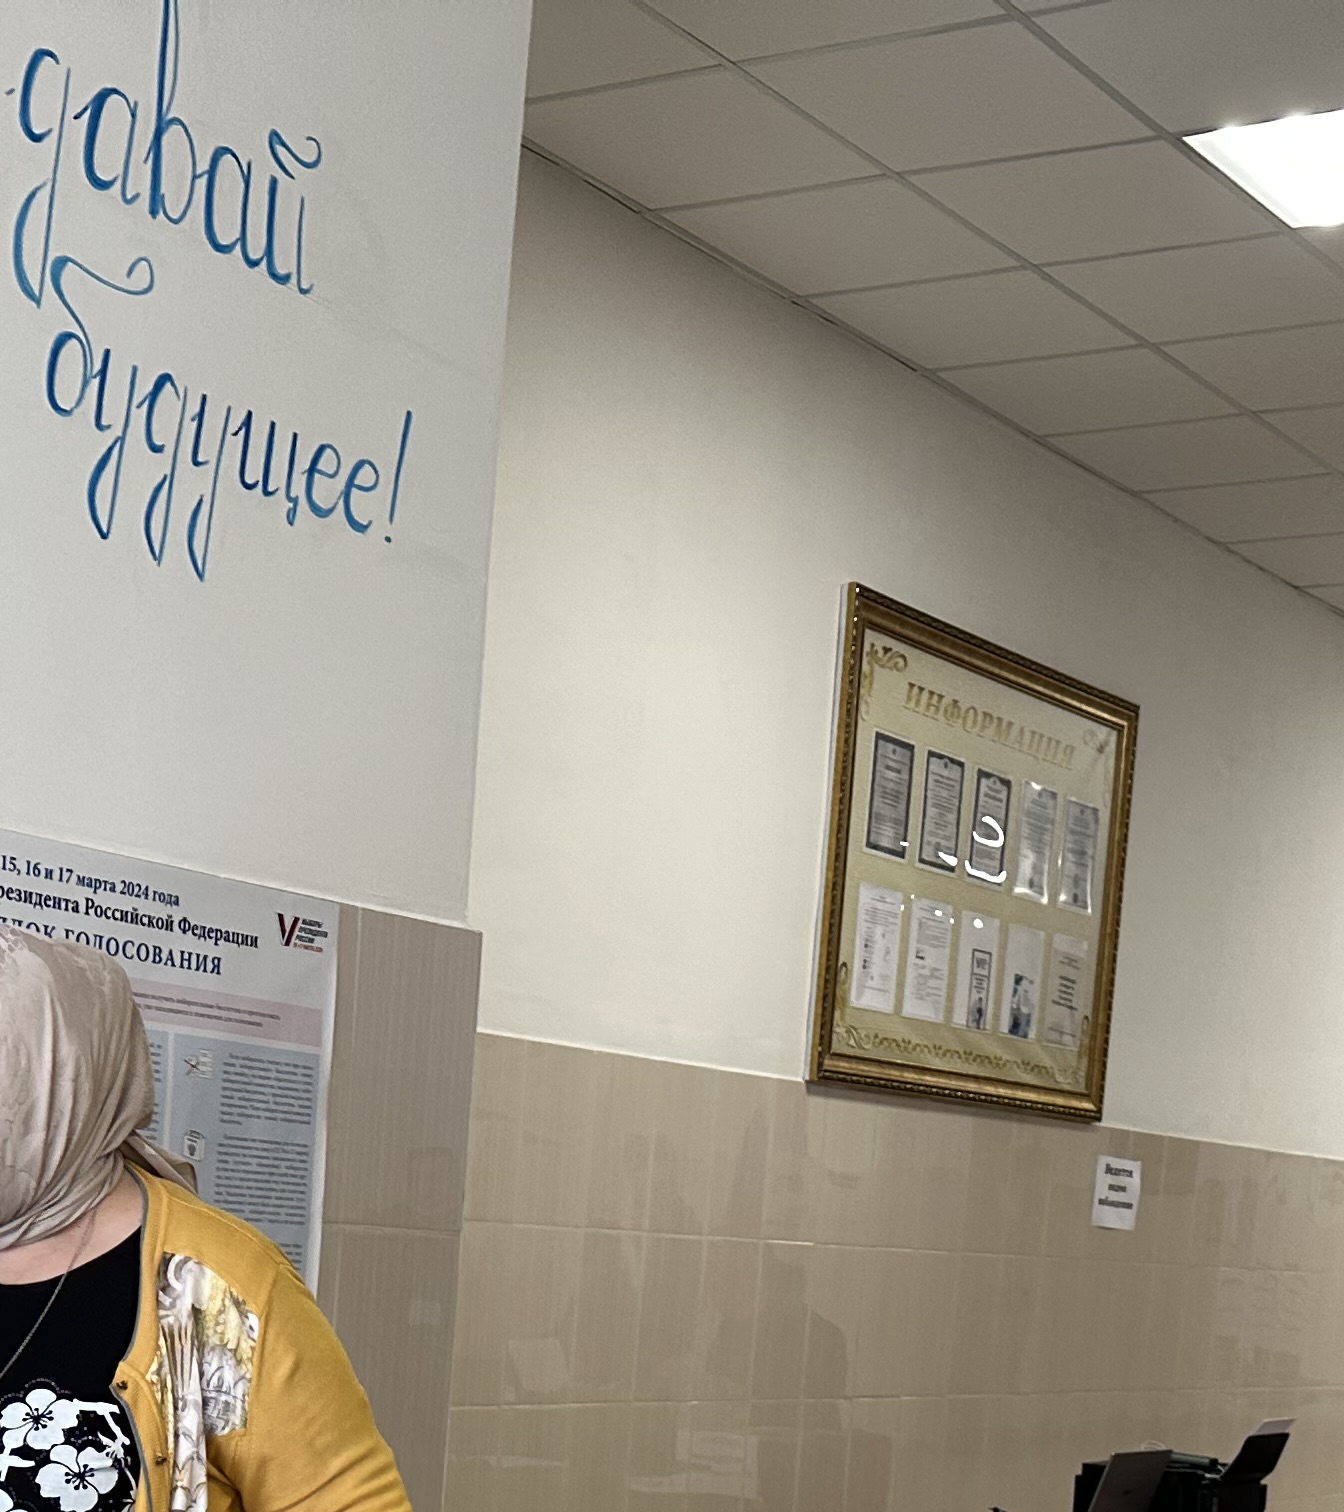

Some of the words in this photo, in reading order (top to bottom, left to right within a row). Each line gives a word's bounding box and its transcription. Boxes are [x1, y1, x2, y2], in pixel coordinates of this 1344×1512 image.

[47, 256, 412, 582] будущее!
[904, 681, 1076, 770] ИНФОРМАЦИЯ
[1, 855, 21, 876] 15,
[26, 860, 41, 877] 16
[44, 868, 54, 881] и
[58, 867, 73, 884] 17
[76, 874, 117, 894] марта
[120, 880, 150, 900] 2024
[153, 889, 180, 907] года
[84, 897, 175, 932] Российской
[178, 916, 259, 949] Федерации
